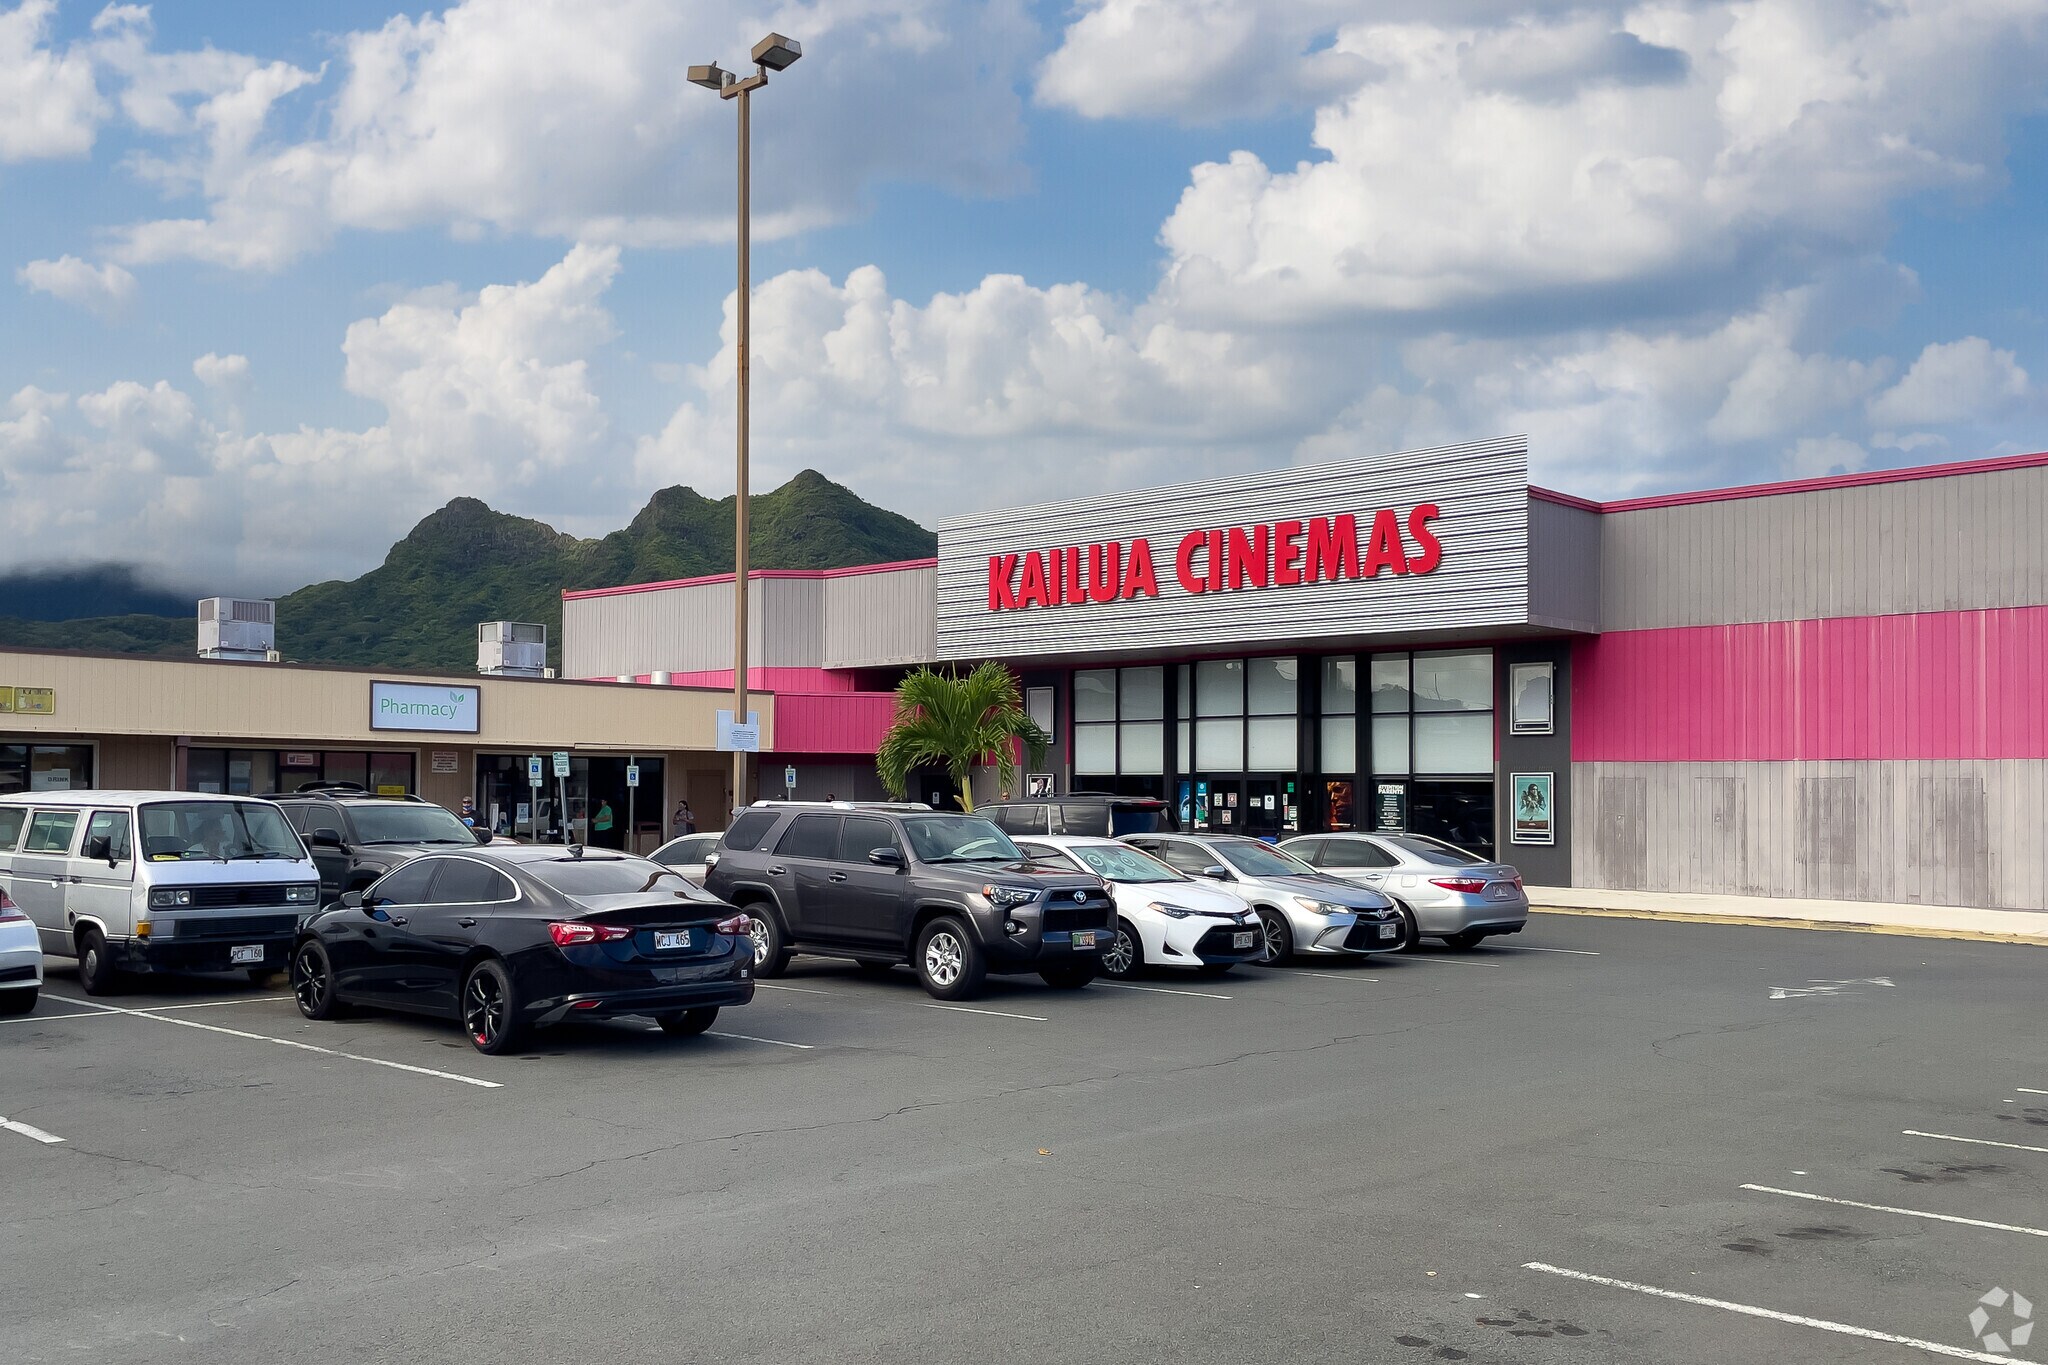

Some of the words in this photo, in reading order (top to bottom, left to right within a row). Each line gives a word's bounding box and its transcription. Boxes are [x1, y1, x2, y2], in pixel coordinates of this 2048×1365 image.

[988, 538, 1159, 611] KAILUA
[1176, 503, 1442, 595] CINEMAS
[381, 698, 457, 719] Pharmacy
[656, 935, 671, 947] WCJ
[676, 934, 690, 946] 465
[250, 948, 263, 958] 160
